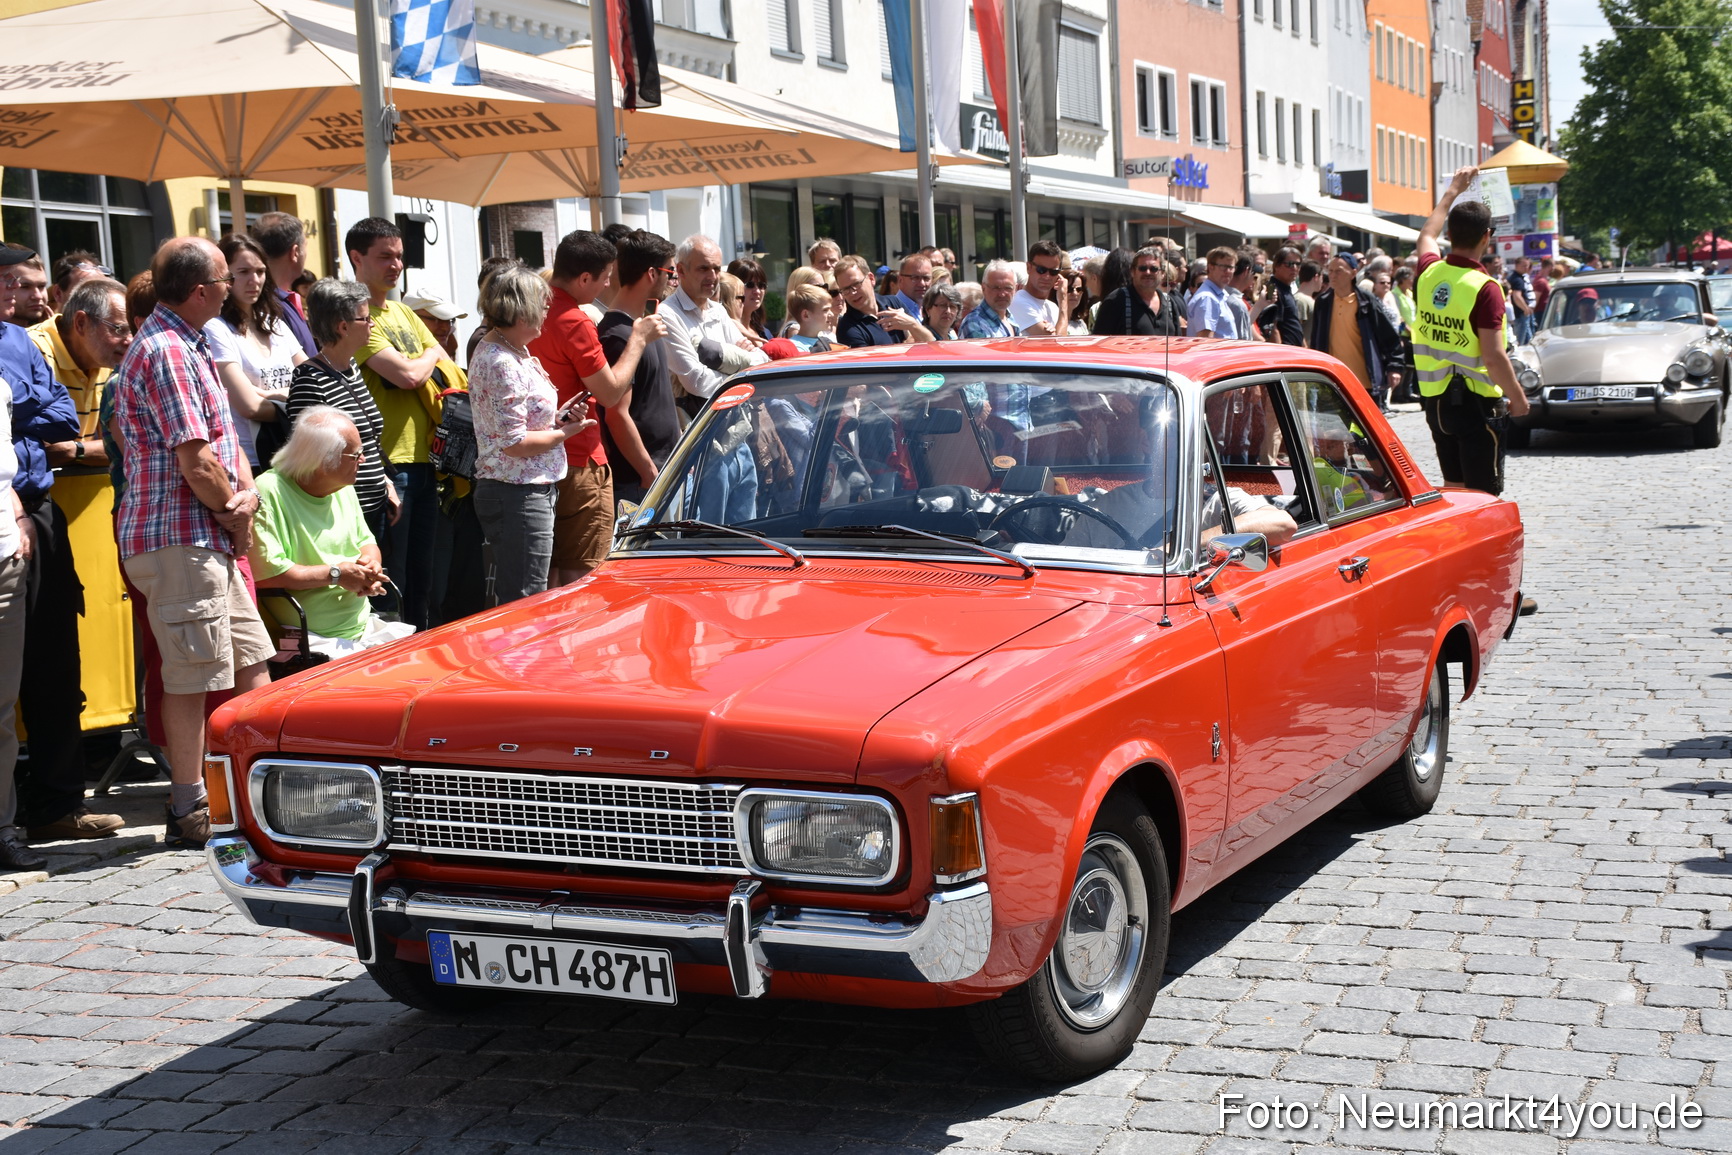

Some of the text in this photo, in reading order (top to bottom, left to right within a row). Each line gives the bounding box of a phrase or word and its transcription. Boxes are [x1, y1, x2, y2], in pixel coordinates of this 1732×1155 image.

[1432, 329, 1450, 344] ME
[428, 737, 670, 760] FORD
[440, 963, 449, 975] D
[453, 940, 671, 997] N CH 487H
